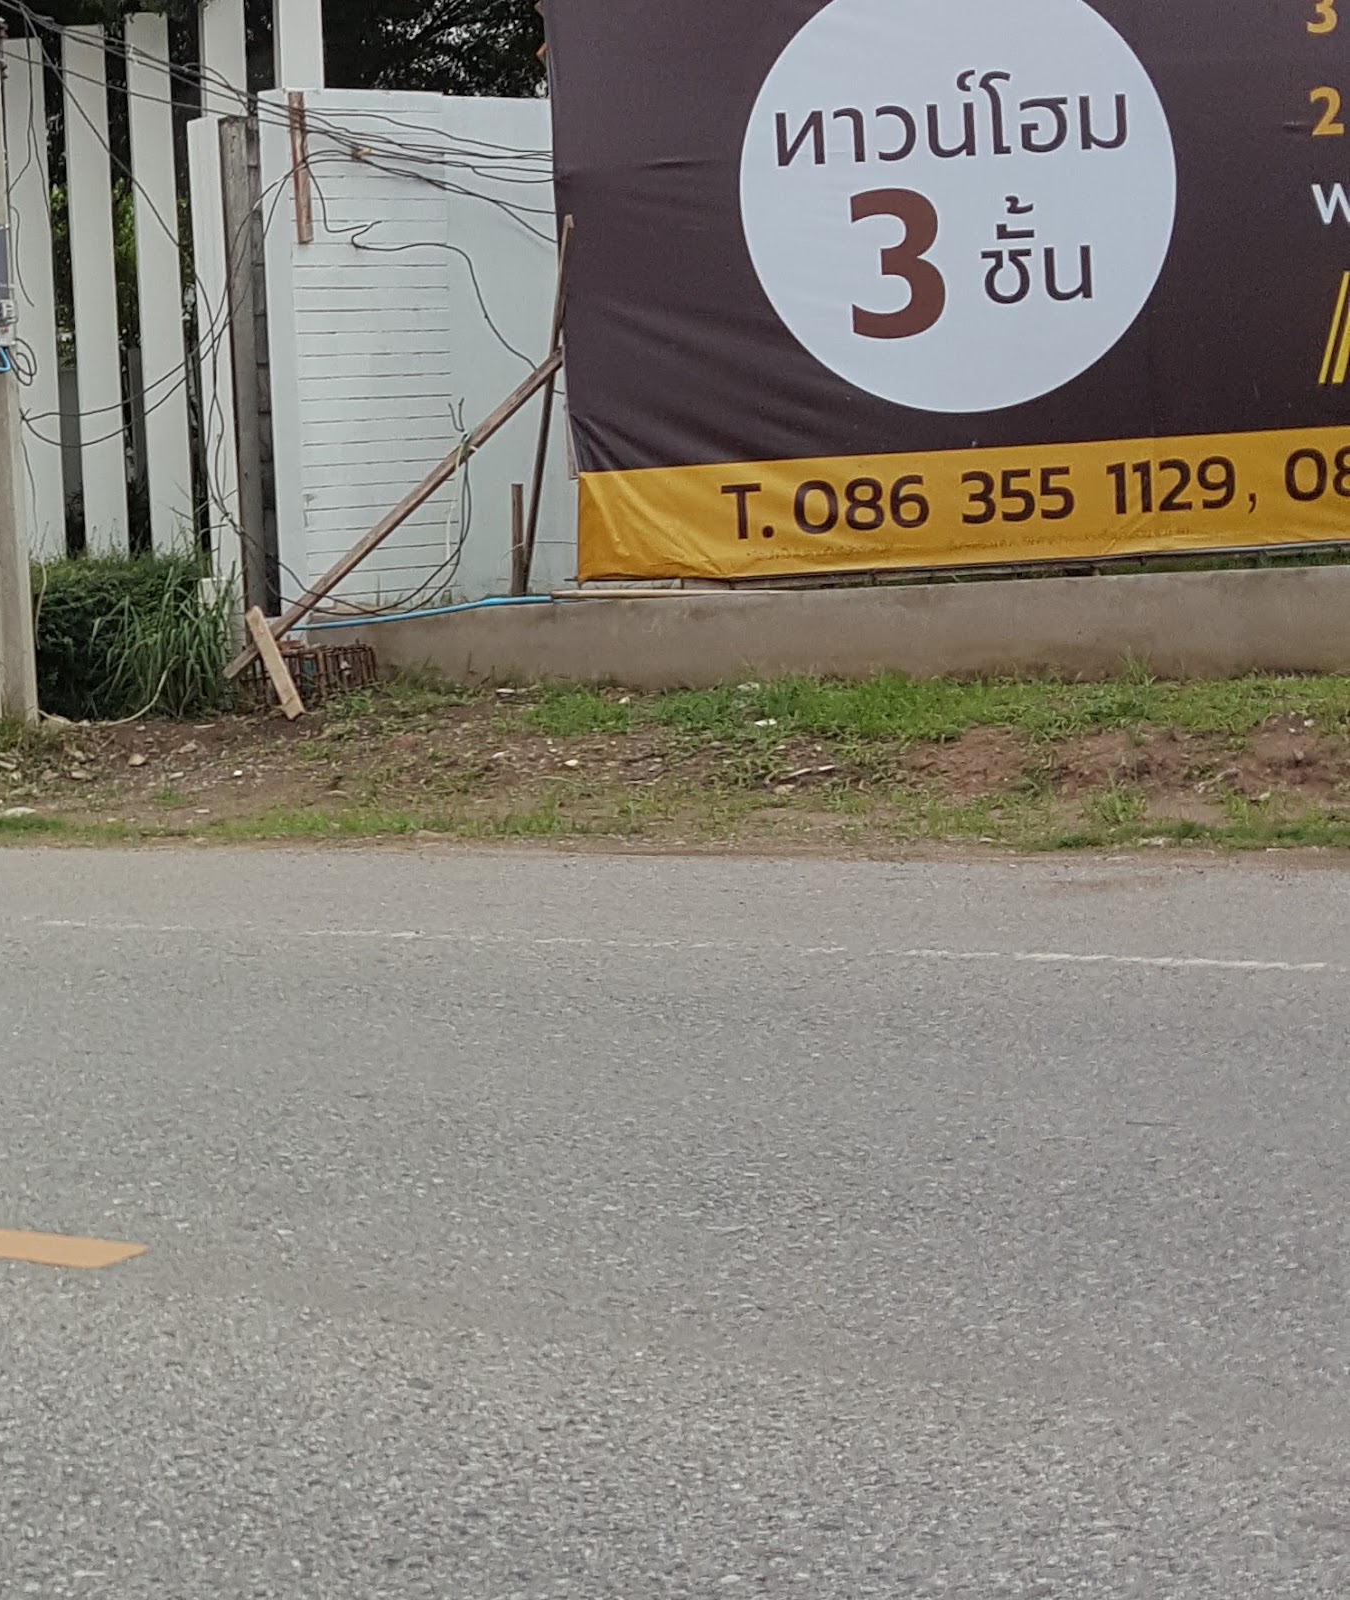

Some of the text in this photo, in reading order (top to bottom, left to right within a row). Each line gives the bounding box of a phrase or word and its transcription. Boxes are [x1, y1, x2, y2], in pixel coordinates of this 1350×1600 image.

[774, 69, 1129, 168] ทาวน์โฮม
[1310, 87, 1345, 136] 2
[849, 188, 1094, 340] 3 ชั้น
[793, 474, 930, 535] 086
[961, 466, 1076, 524] 355
